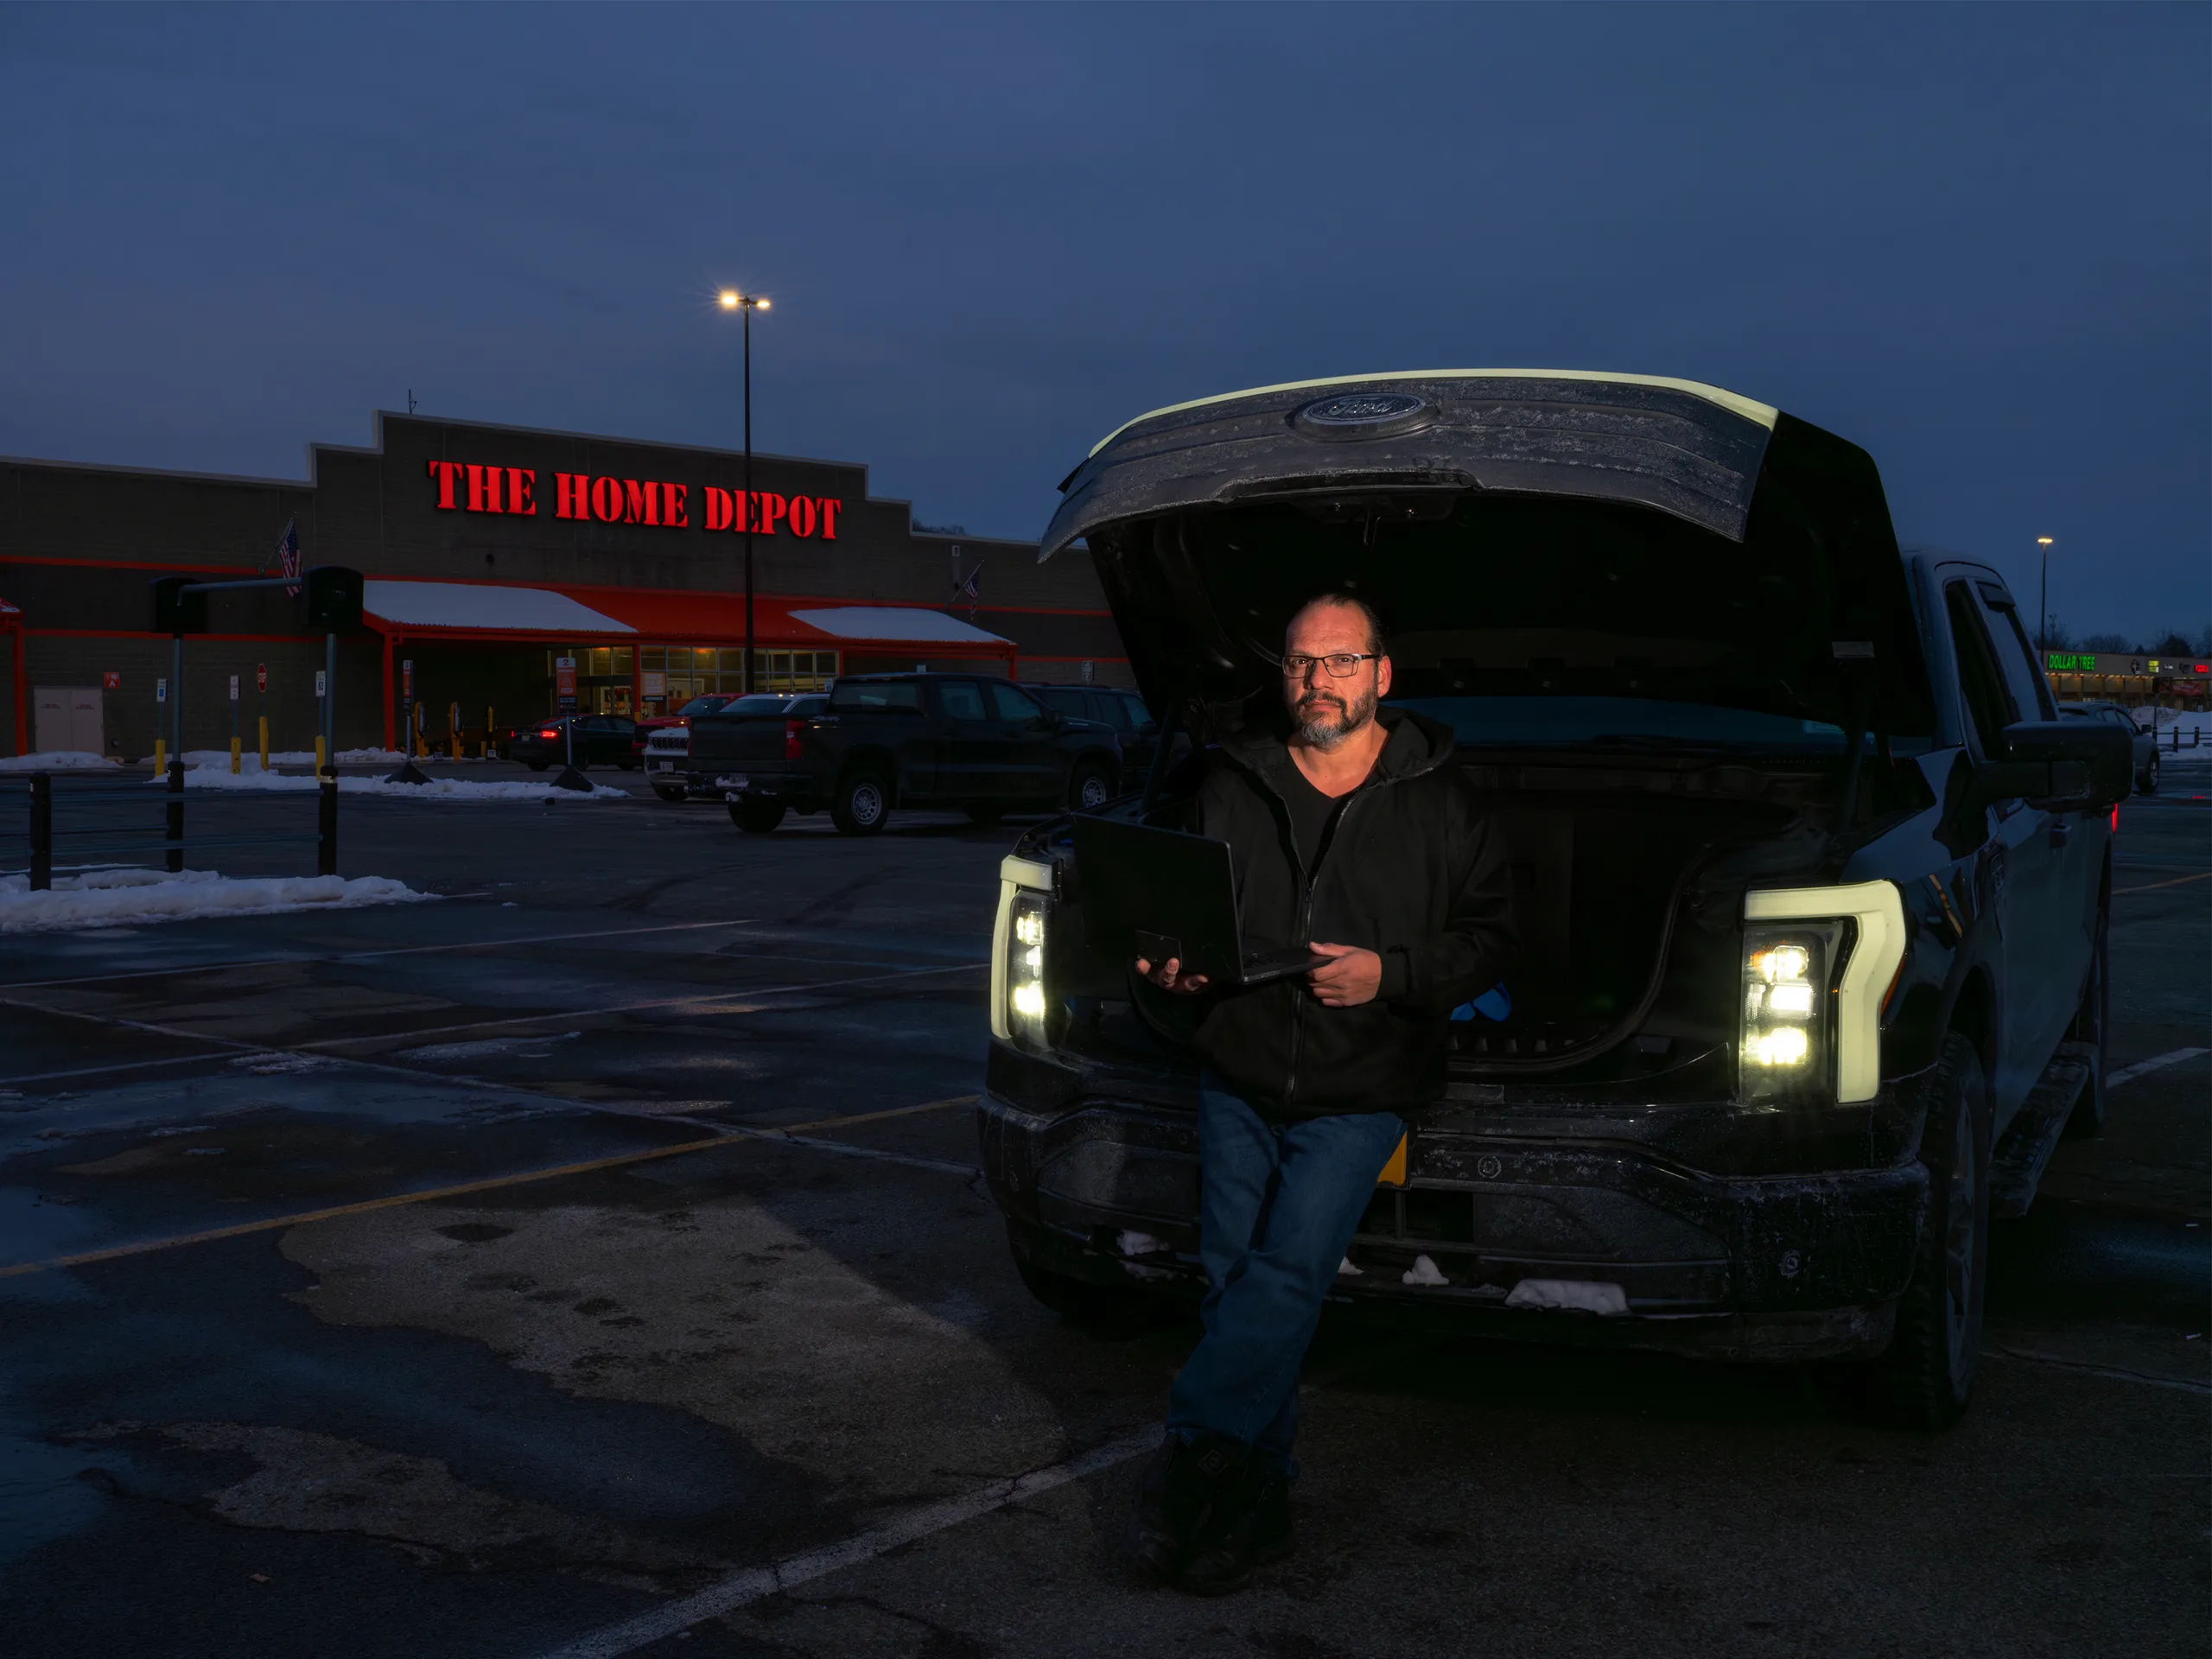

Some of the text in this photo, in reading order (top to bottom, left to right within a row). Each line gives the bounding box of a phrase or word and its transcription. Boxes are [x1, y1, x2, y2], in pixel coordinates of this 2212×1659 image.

[1328, 397, 1395, 416] Ford
[429, 460, 842, 540] THE HOME DEPOT
[2049, 654, 2095, 671] DOLLAR TREE
